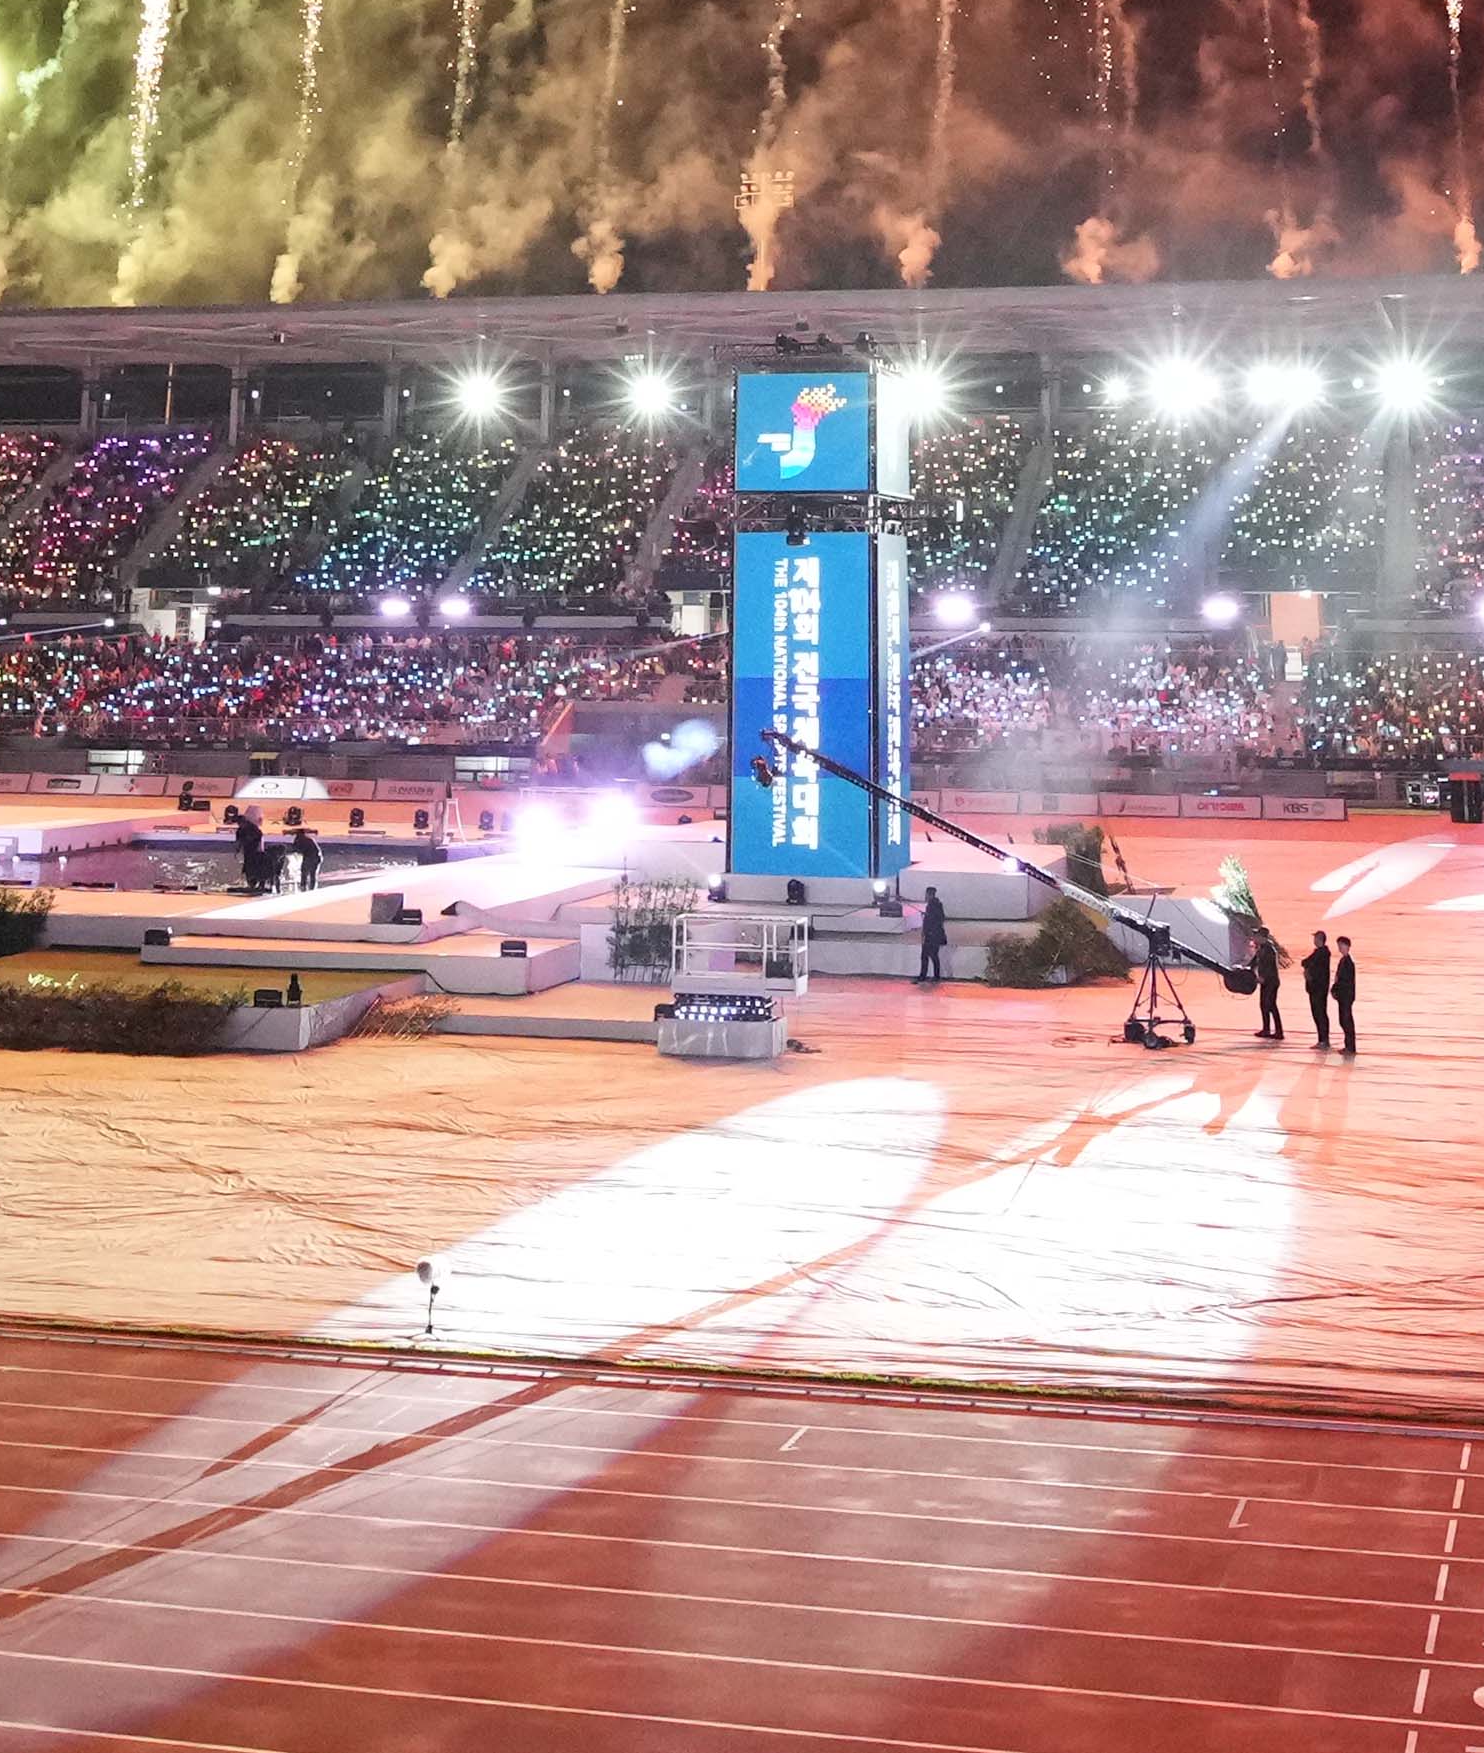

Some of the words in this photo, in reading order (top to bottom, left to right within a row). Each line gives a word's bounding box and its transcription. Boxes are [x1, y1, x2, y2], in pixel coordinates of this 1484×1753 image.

[774, 558, 789, 588] THE
[773, 591, 788, 632] 104th
[788, 556, 821, 645] 제104회
[772, 635, 788, 711] NATIONAL
[1282, 801, 1309, 815] KBS
